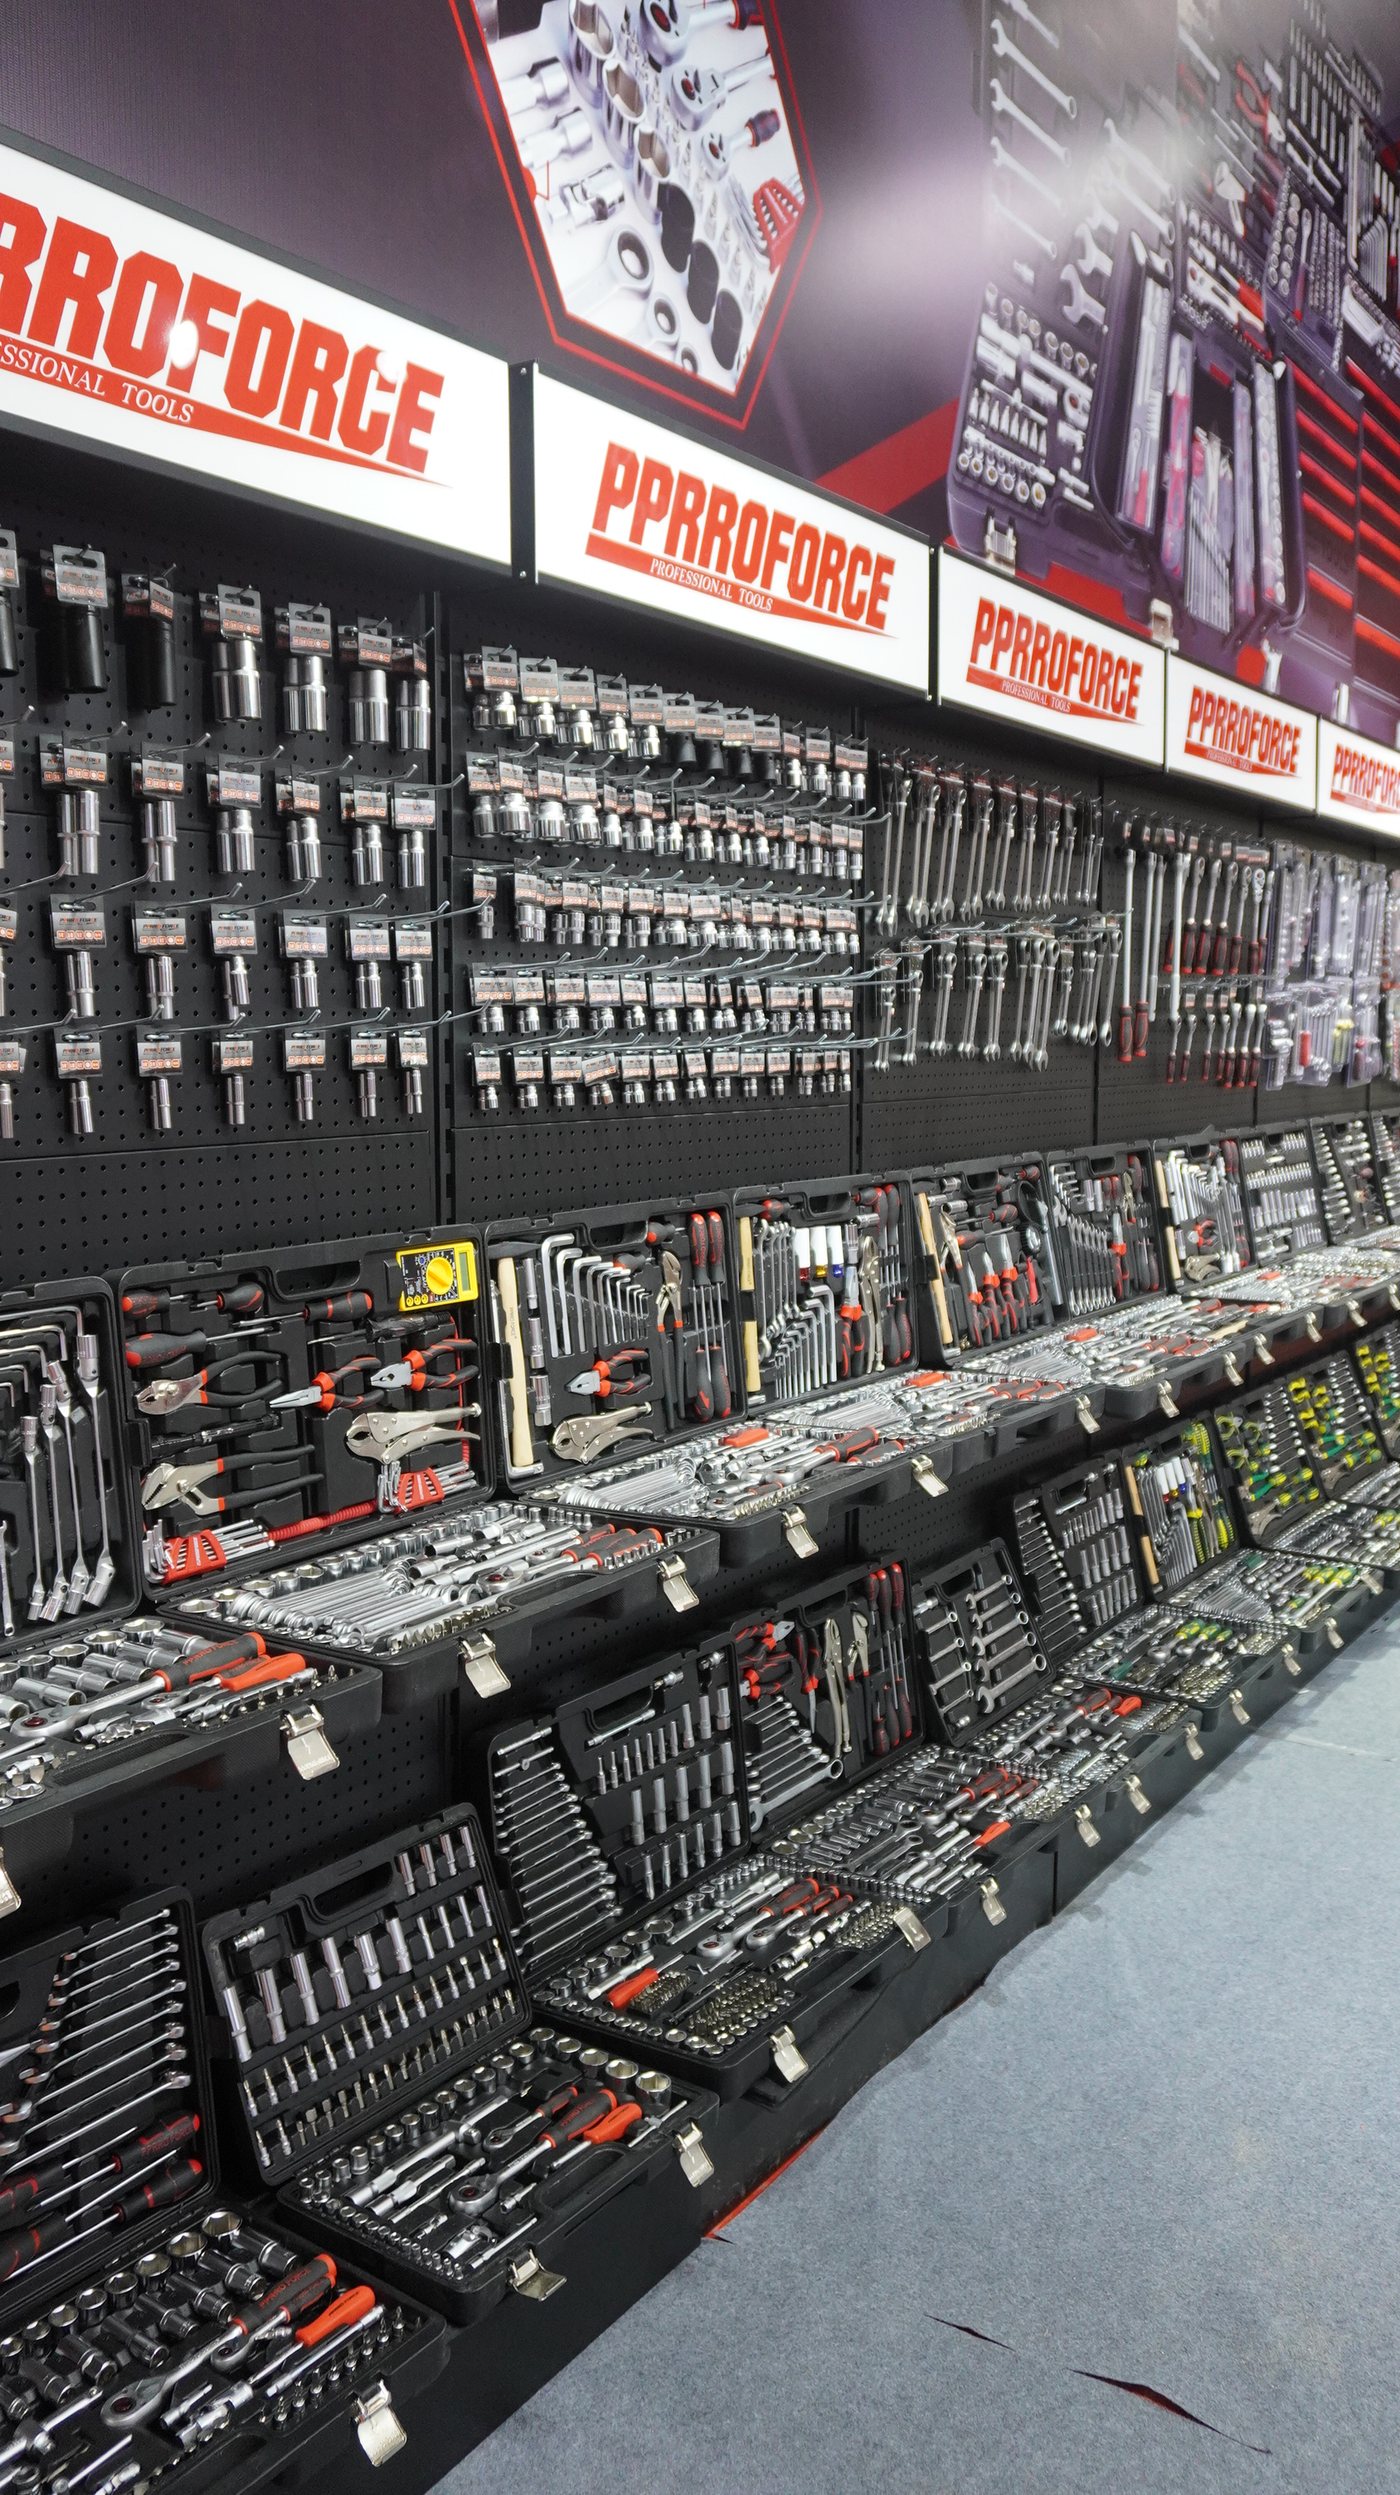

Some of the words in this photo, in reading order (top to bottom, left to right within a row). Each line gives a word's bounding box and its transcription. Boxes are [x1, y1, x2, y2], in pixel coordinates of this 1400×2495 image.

[0, 341, 106, 396] SSIONAL
[121, 382, 195, 423] TOOLS
[591, 440, 896, 631] PPRROFORCE
[649, 557, 733, 600] PROFESSIONAL
[738, 588, 774, 613] TOOLS
[970, 596, 1144, 720] PPRROFORCE
[1001, 679, 1049, 707] PROFESSIONAL
[1050, 695, 1072, 713] TOOLS
[1186, 684, 1303, 773] PPRROFORCE
